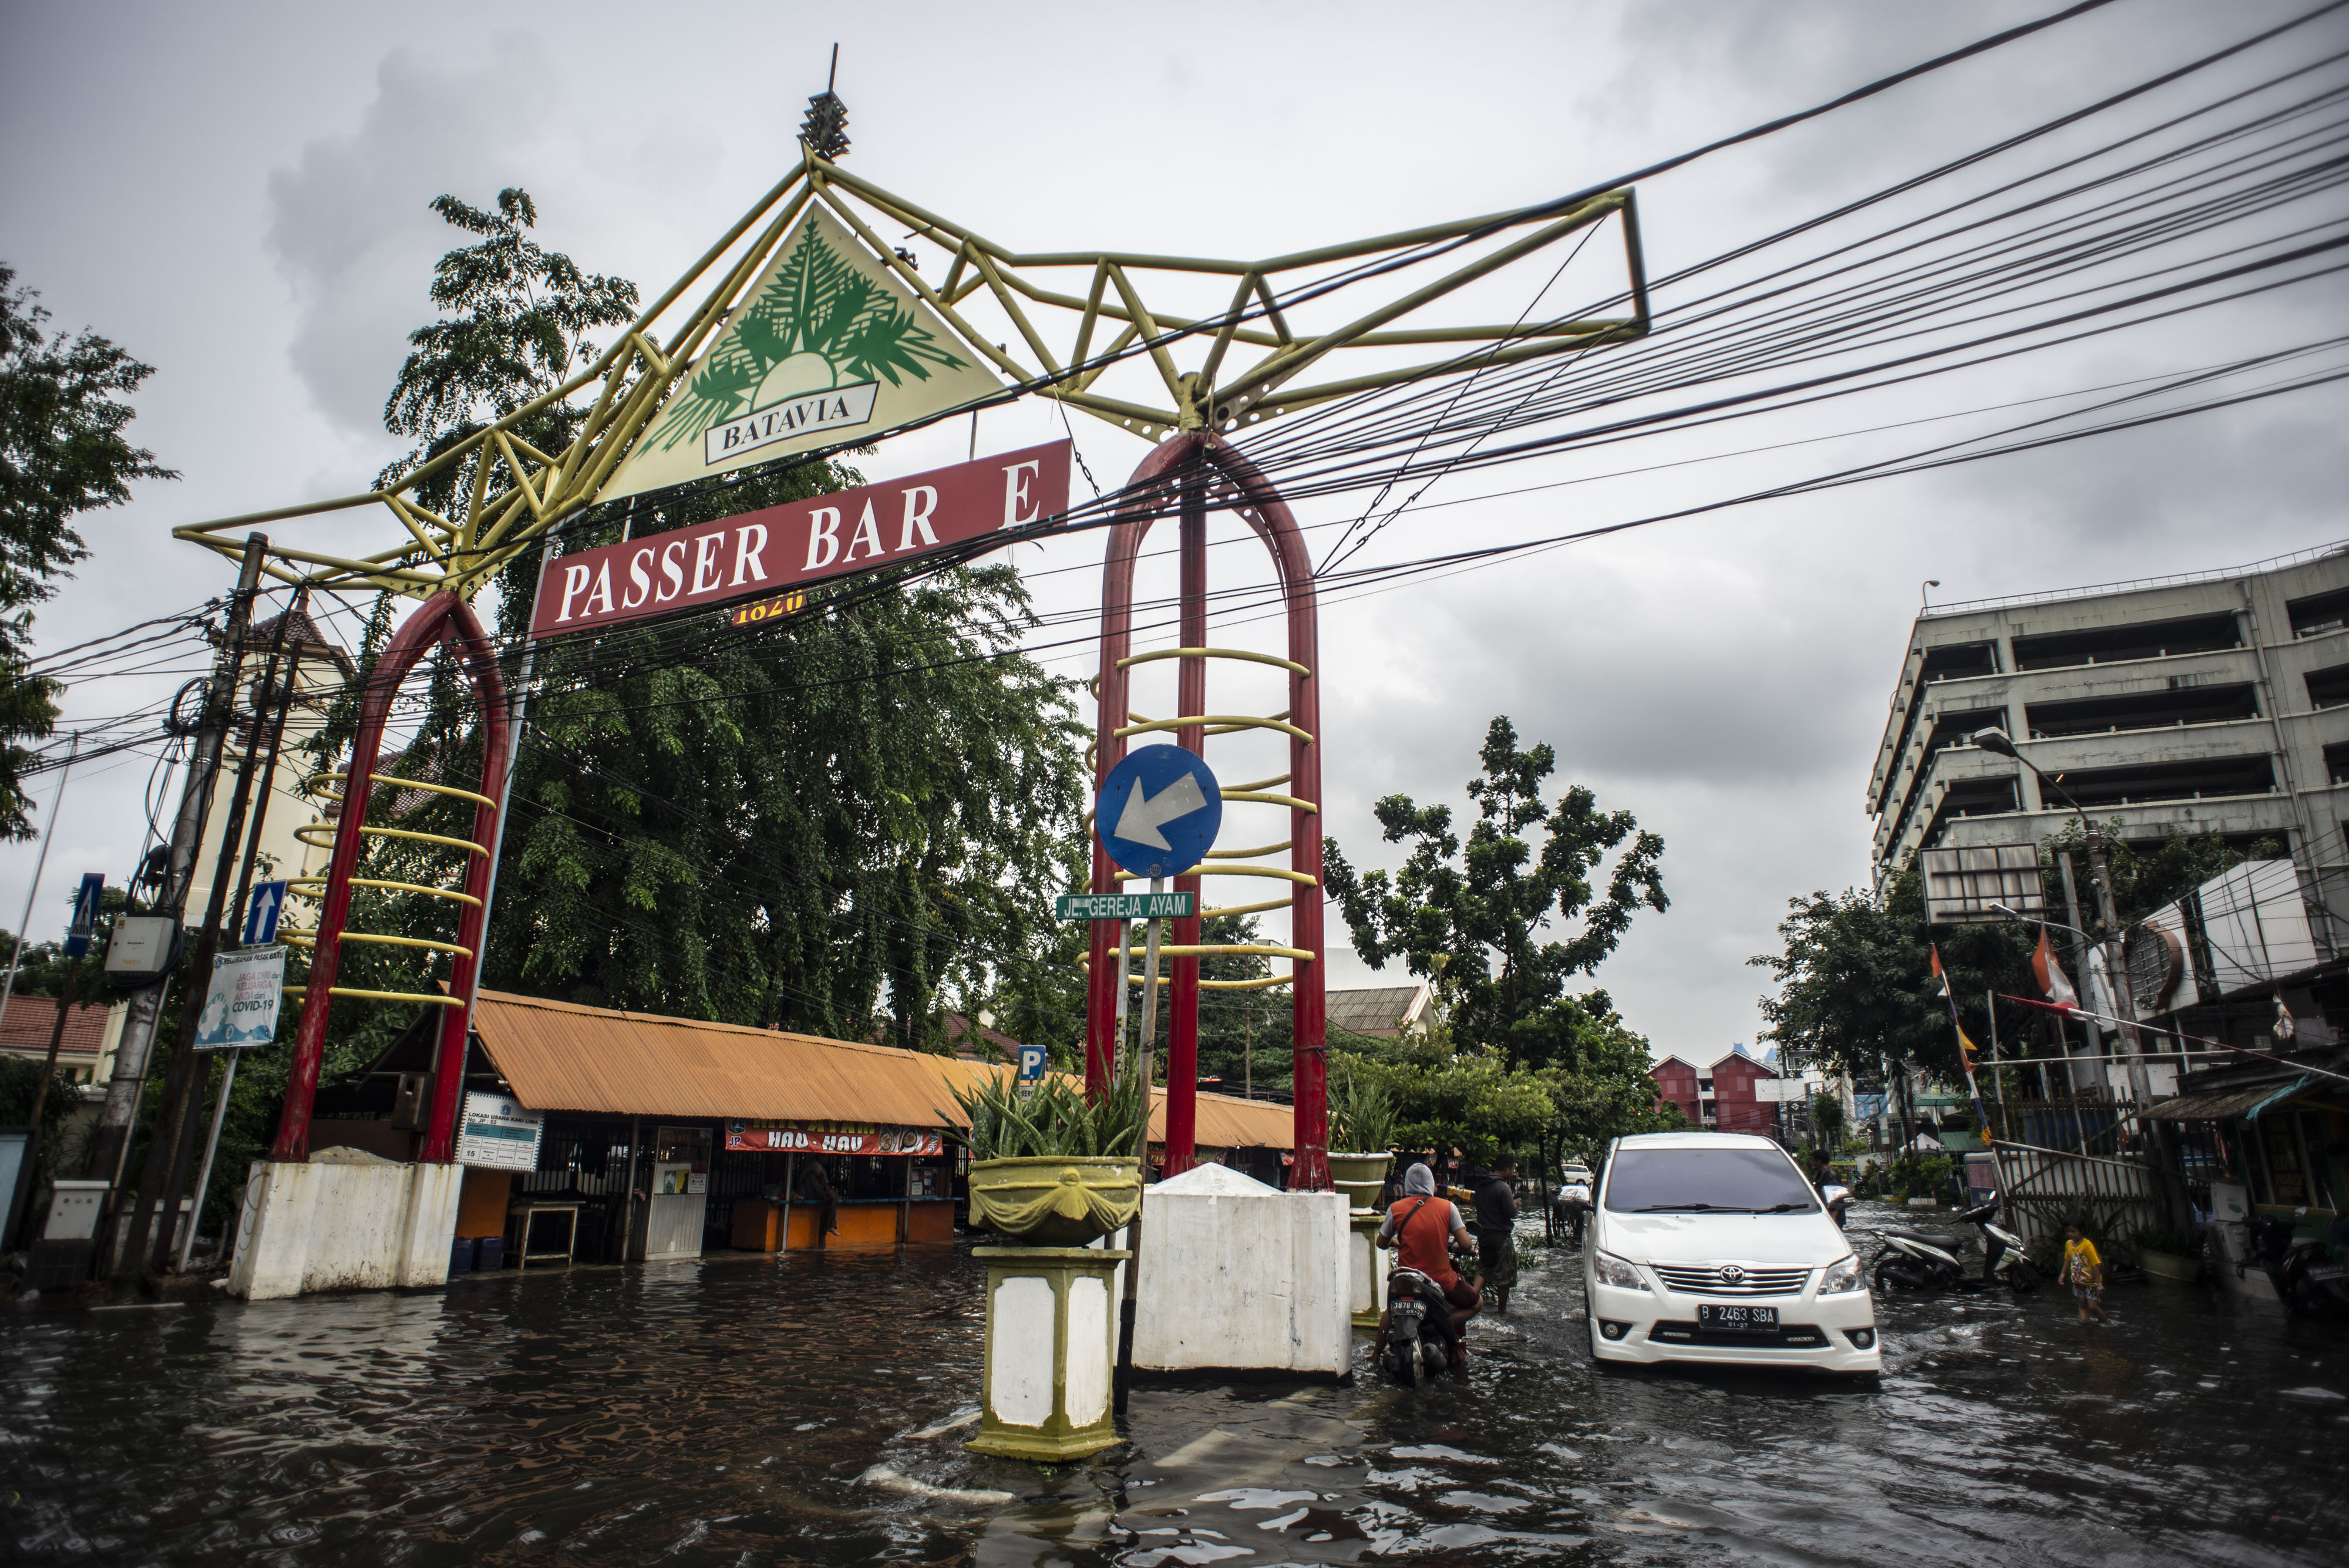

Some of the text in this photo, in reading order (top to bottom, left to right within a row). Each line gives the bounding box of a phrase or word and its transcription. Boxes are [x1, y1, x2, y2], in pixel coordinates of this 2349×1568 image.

[722, 396, 850, 451] BATAVIA
[555, 523, 768, 624] PASSER
[736, 589, 803, 624] 1820
[1089, 896, 1142, 916] GEREJA
[1149, 895, 1186, 915] AYAM
[236, 981, 272, 991] KELUARGA
[237, 972, 256, 982] JAGA
[256, 971, 271, 981] DIRI
[233, 999, 274, 1012] COVID-19
[235, 991, 266, 1001] ANDA dari
[1022, 1050, 1041, 1075] P
[729, 1136, 742, 1147] JP
[766, 1130, 809, 1149] HAU
[822, 1135, 863, 1152] HAU
[1702, 1305, 1773, 1323] B 2463 SBA
